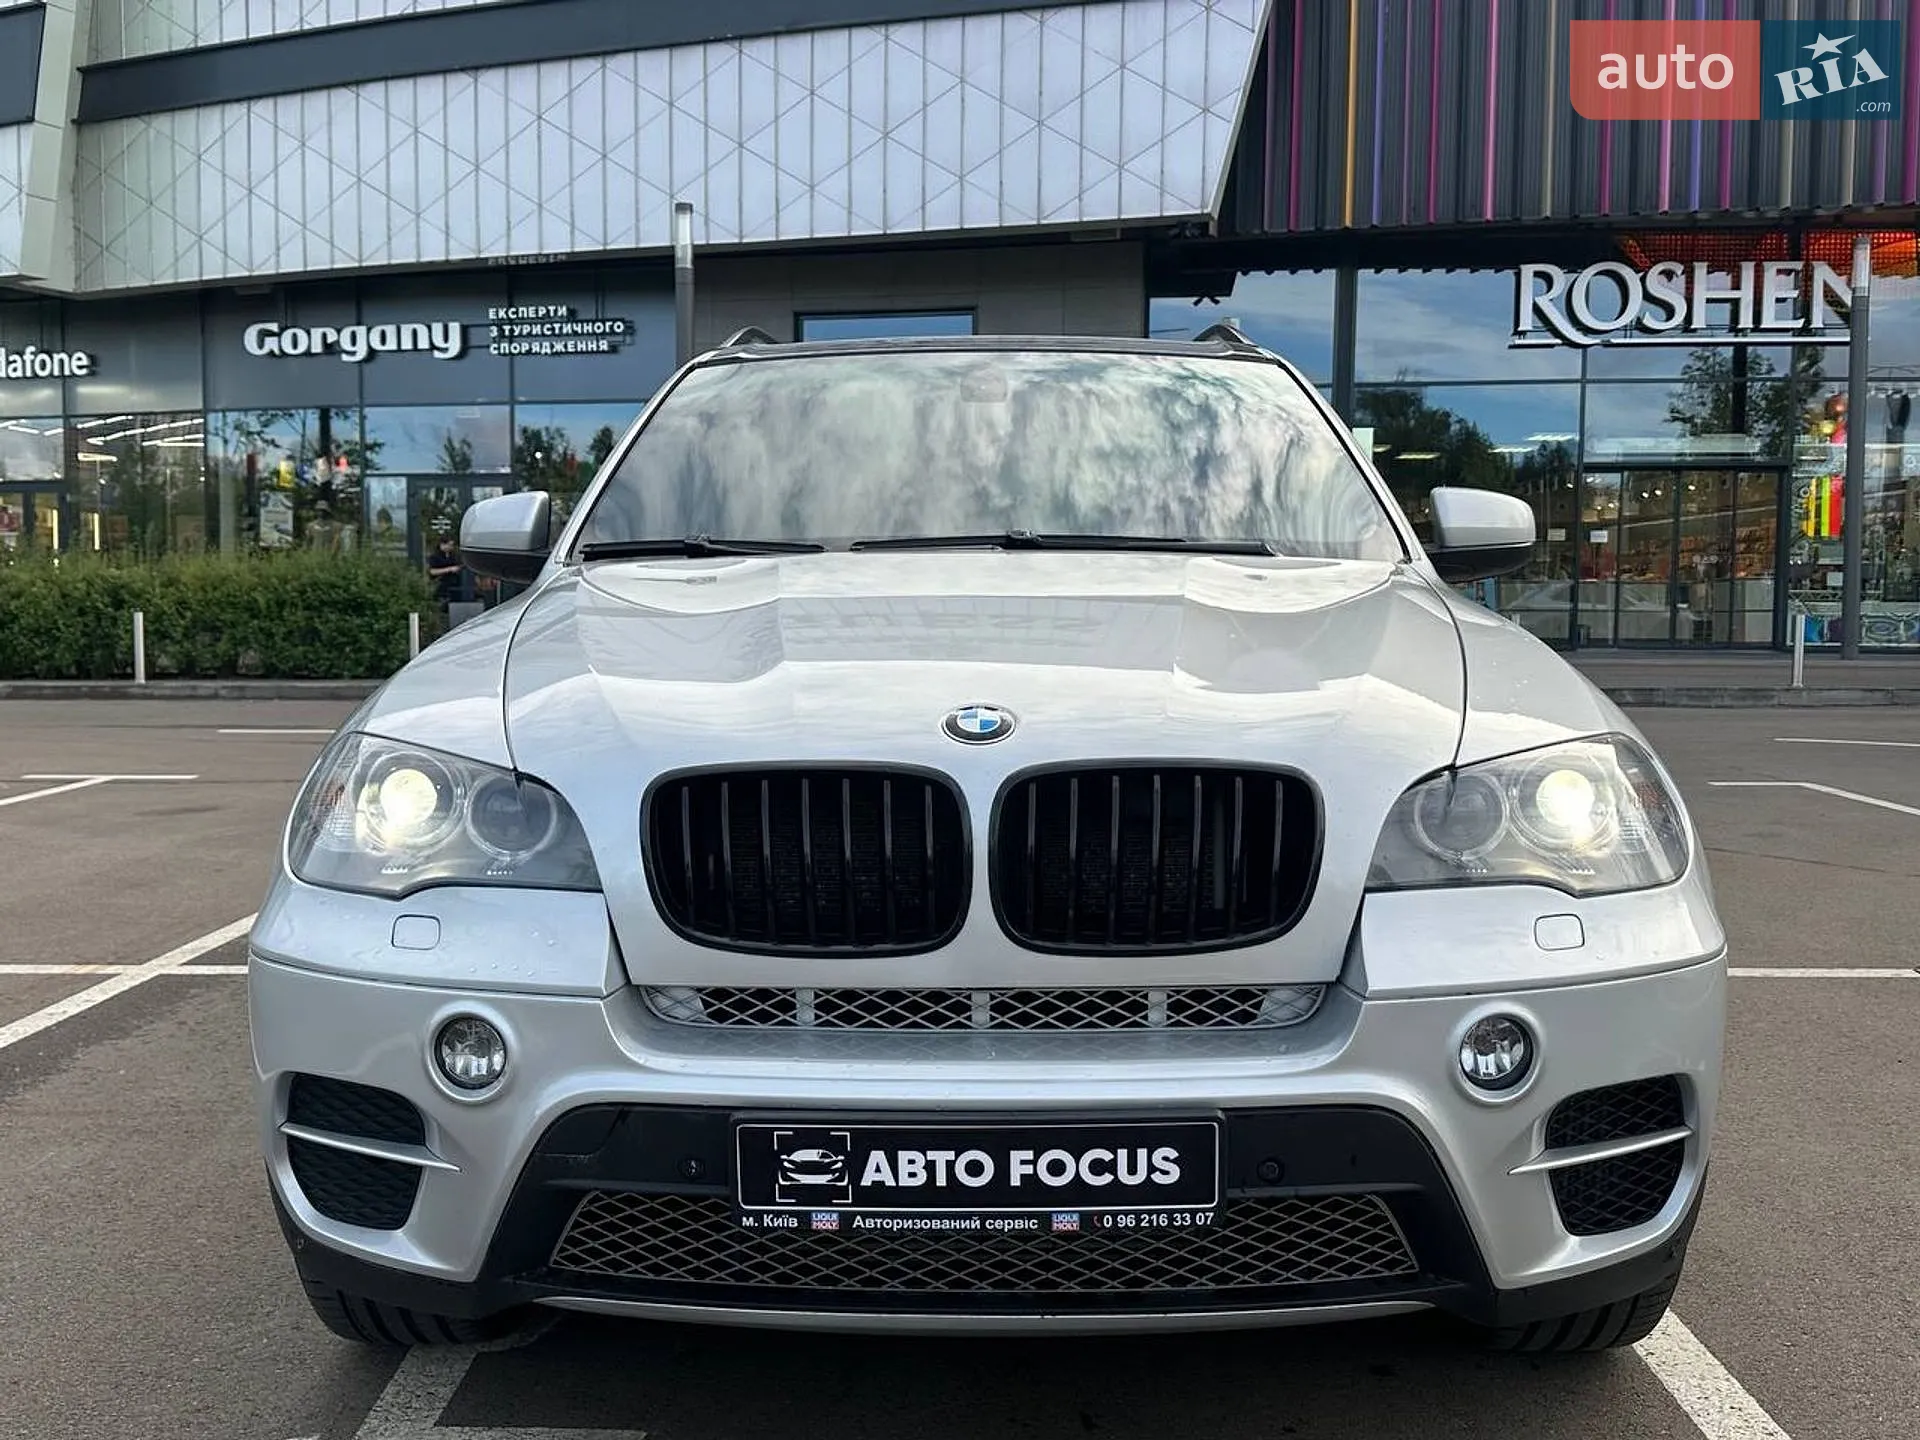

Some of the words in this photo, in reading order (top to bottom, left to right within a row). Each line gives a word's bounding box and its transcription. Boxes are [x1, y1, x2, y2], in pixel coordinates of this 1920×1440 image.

[1516, 261, 1852, 345] ROSHEN
[488, 305, 568, 319] ЕКСПЕРТИ
[502, 321, 624, 336] ТУРИСТИЧНОГО
[244, 321, 462, 363] Gorgany
[490, 340, 609, 354] СПОРЯДЖЕННЯ
[1009, 1147, 1181, 1186] FOCUS
[742, 1216, 759, 1227] м.
[763, 1214, 798, 1228] Київ
[852, 1214, 981, 1231] Авторизований
[985, 1217, 1039, 1232] сервіс
[1103, 1214, 1112, 1228] 0
[1116, 1214, 1136, 1227] 96
[1140, 1214, 1168, 1227] 216
[1172, 1213, 1191, 1226] 33
[1195, 1212, 1214, 1225] 07
